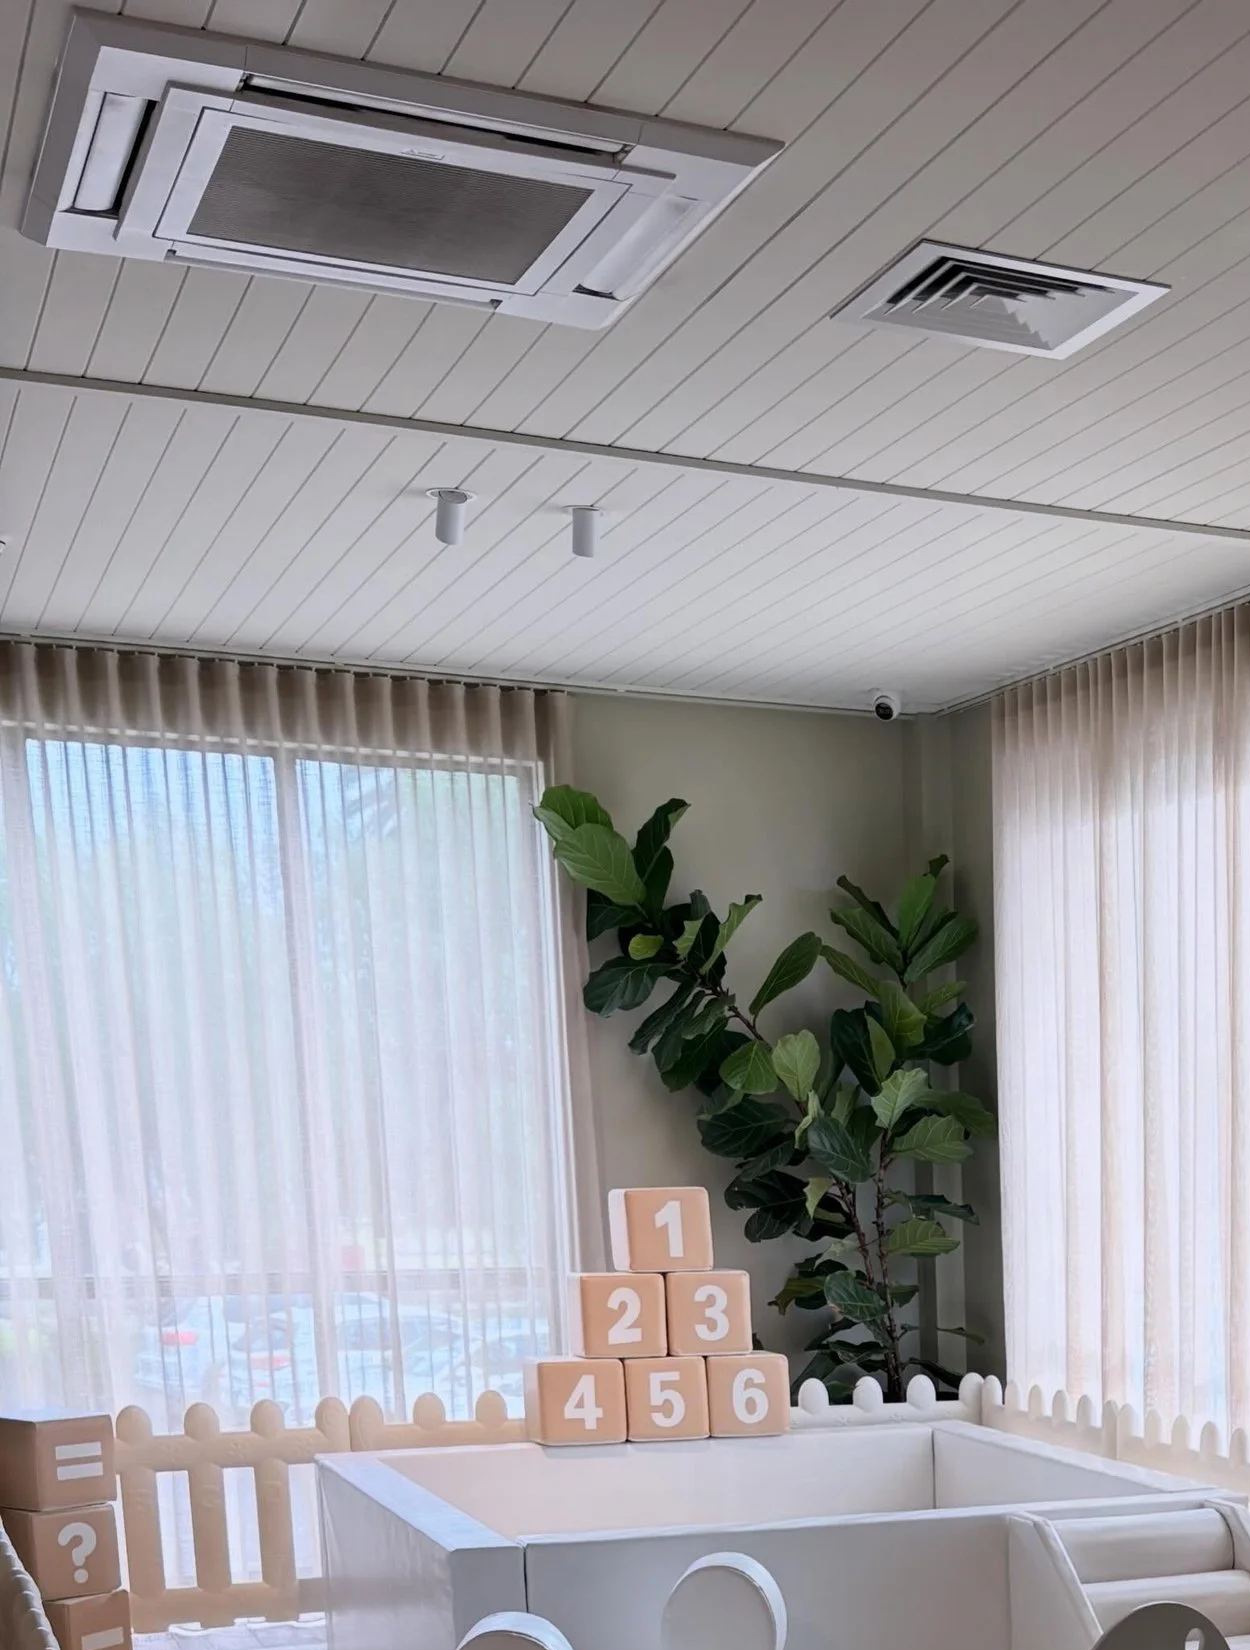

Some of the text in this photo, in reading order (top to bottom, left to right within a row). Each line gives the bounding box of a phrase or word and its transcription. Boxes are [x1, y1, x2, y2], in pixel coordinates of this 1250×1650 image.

[654, 1200, 684, 1258] 1
[607, 1287, 643, 1345] 2
[693, 1284, 730, 1342] 3
[563, 1374, 603, 1430] 4
[649, 1371, 686, 1428] 5
[732, 1368, 769, 1424] 6
[57, 1522, 97, 1584] ?
